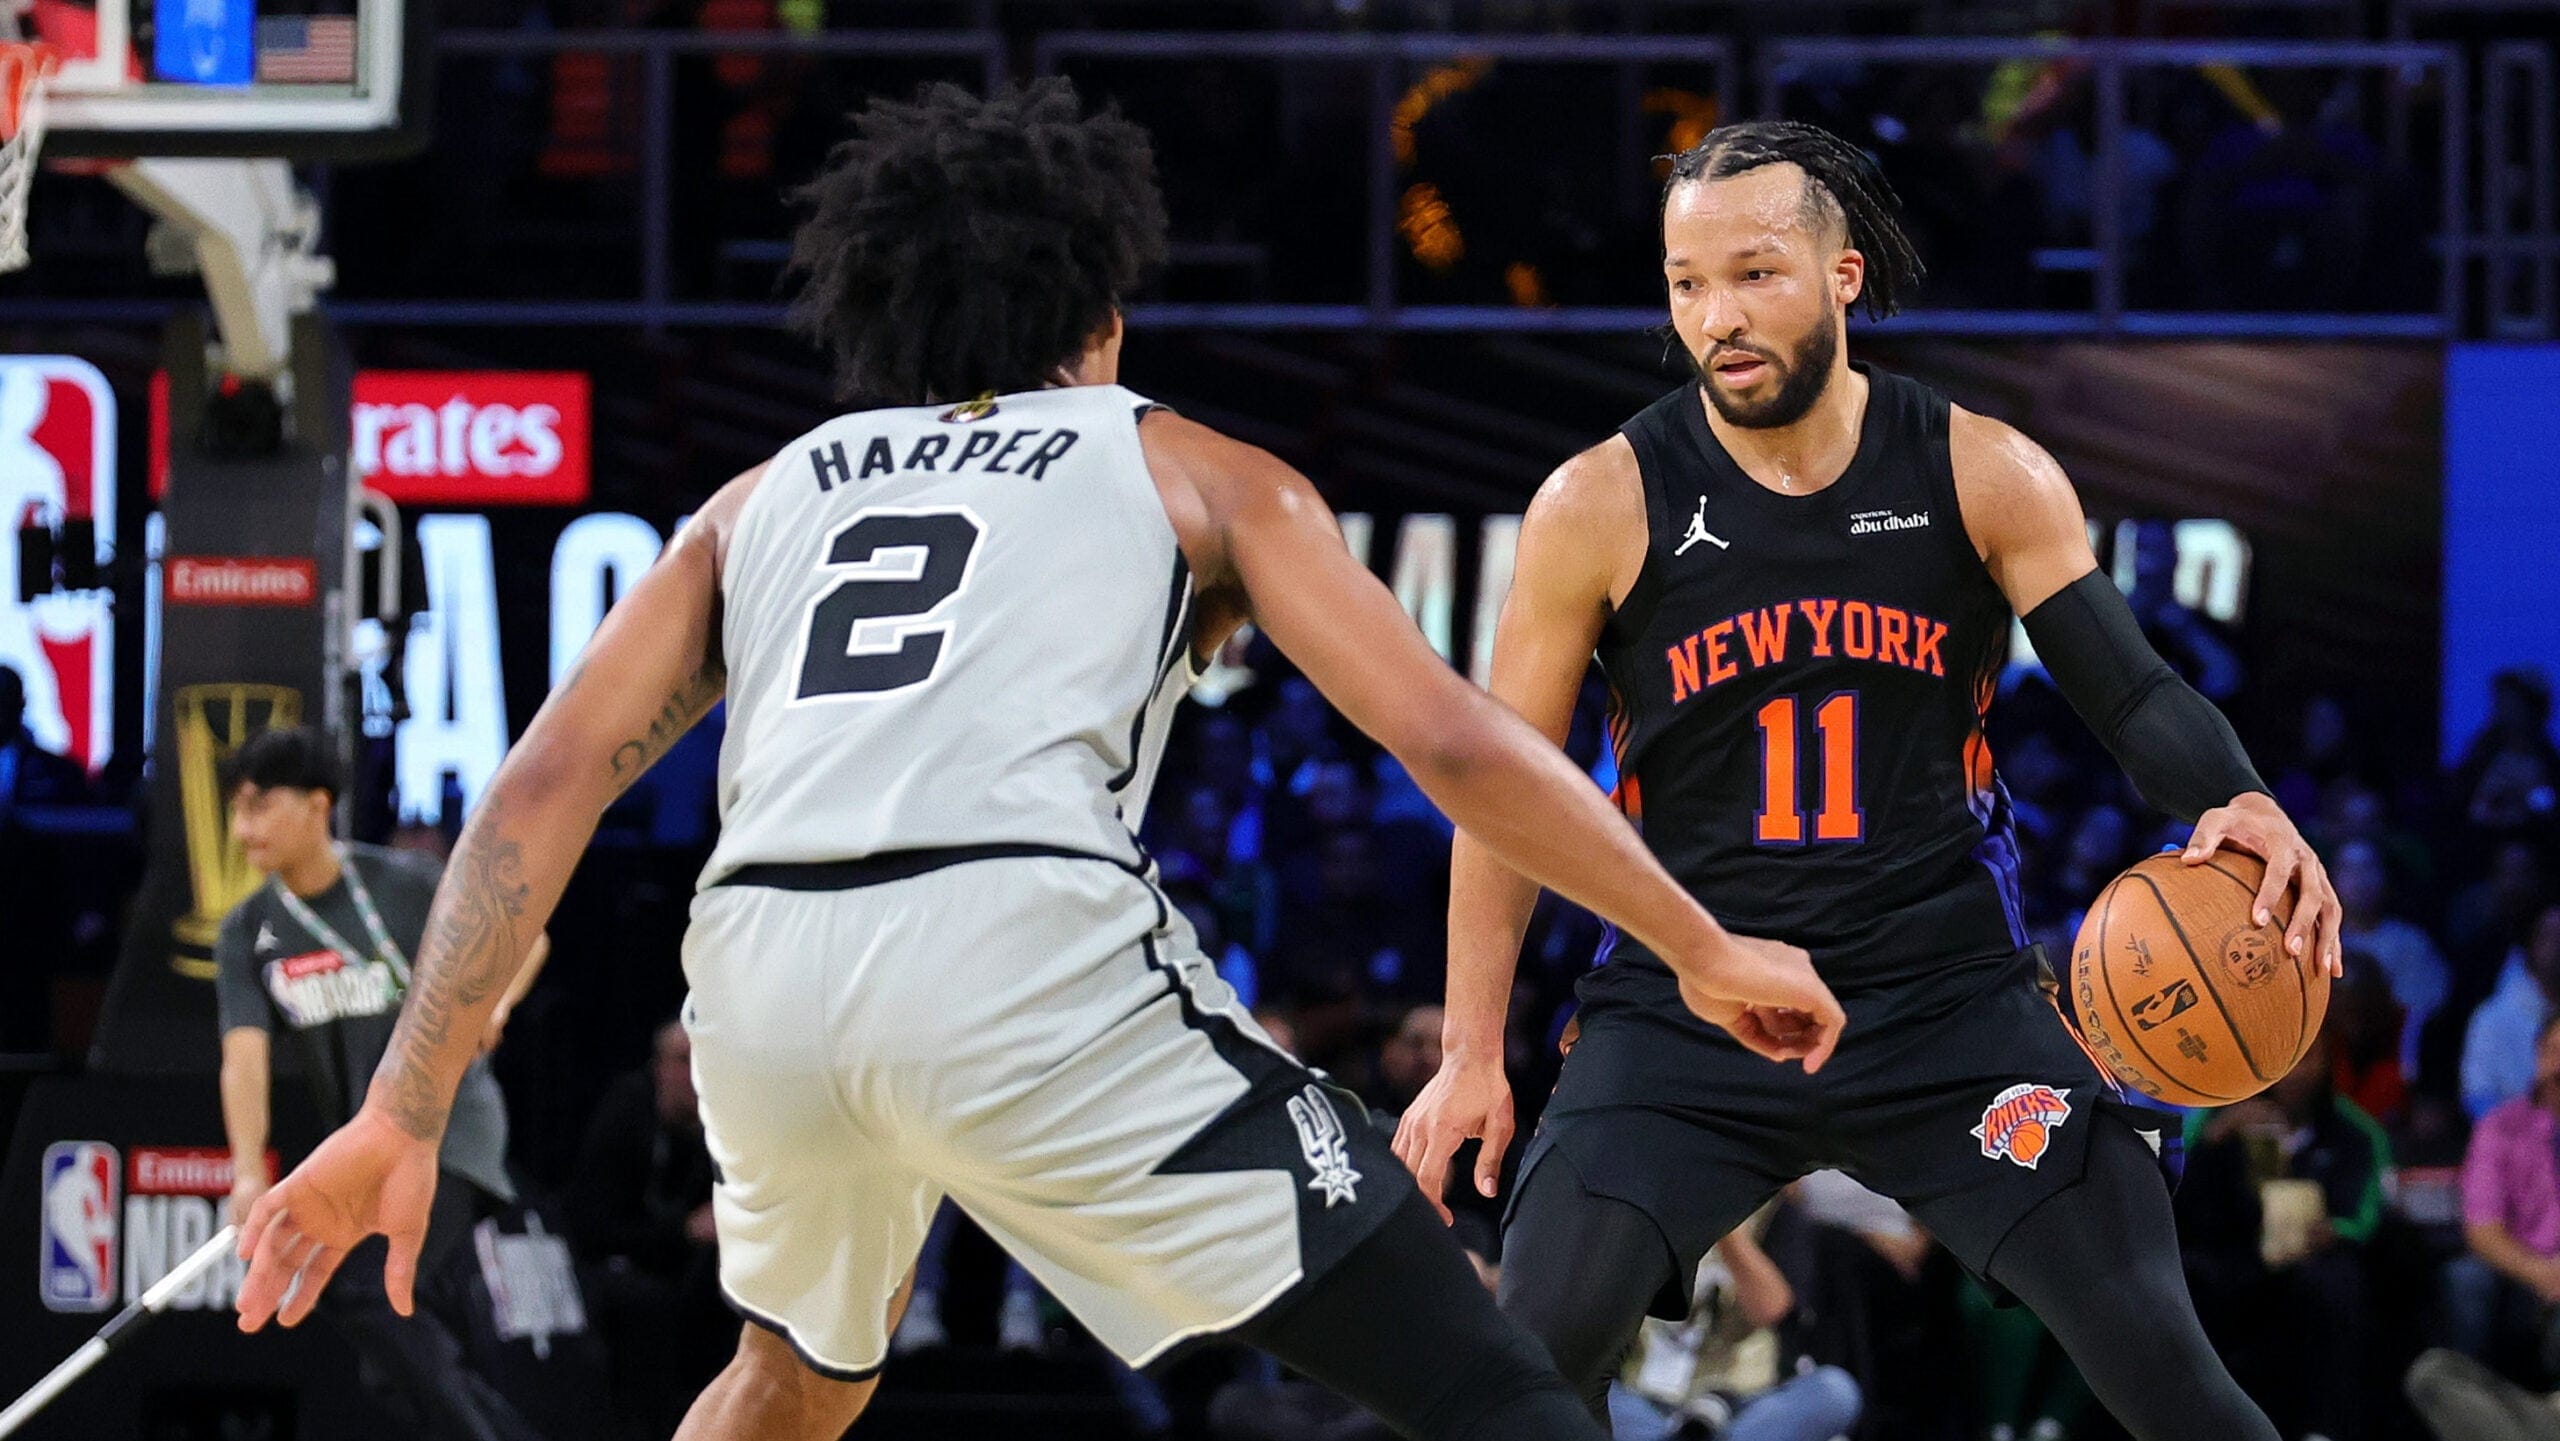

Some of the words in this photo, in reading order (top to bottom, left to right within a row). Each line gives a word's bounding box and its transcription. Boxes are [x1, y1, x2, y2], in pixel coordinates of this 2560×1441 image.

[351, 393, 565, 477] rates
[808, 428, 1079, 492] HARPER
[1850, 519, 1882, 535] abu
[1883, 511, 1930, 530] dhabi
[786, 504, 988, 708] 2
[1666, 602, 1792, 705] NEW
[1798, 598, 1949, 679] YORK
[1752, 689, 1866, 847] 11
[1985, 1087, 2068, 1153] KNICKS
[137, 1152, 234, 1188] Emira
